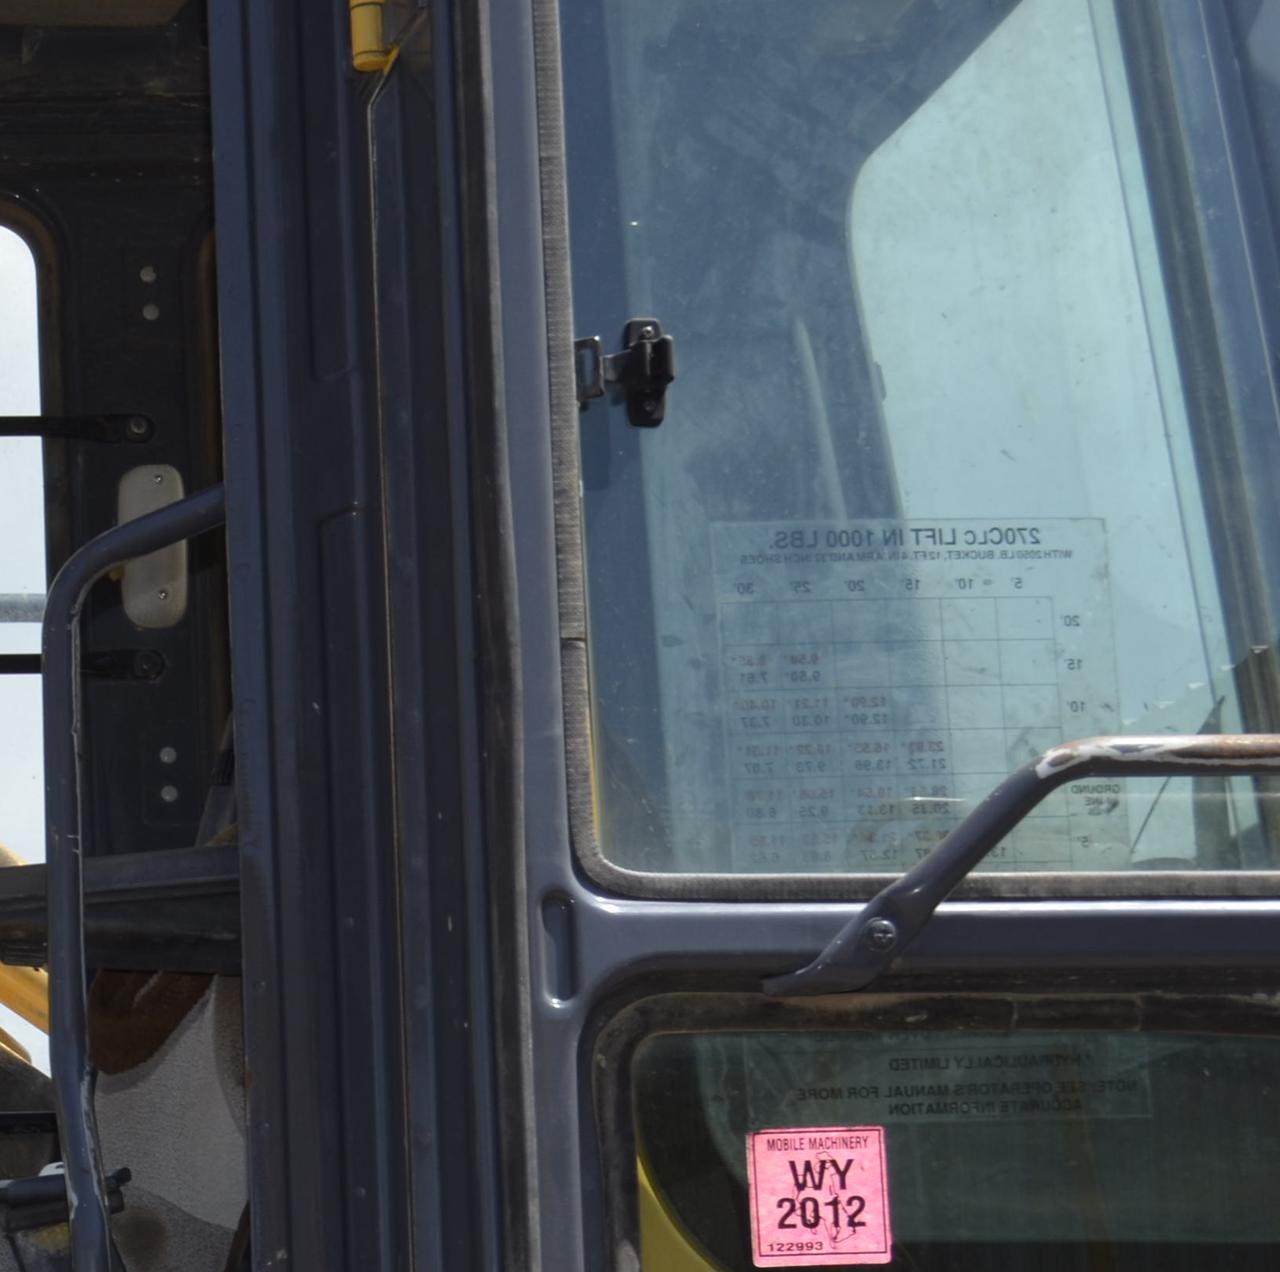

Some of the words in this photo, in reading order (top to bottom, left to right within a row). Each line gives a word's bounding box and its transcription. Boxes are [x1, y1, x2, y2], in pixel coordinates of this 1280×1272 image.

[767, 1138, 805, 1152] MOBILE
[809, 1136, 869, 1151] MACHINERY
[789, 1159, 855, 1191] WY
[776, 1195, 867, 1229] 2012
[769, 1241, 824, 1252] 122993
